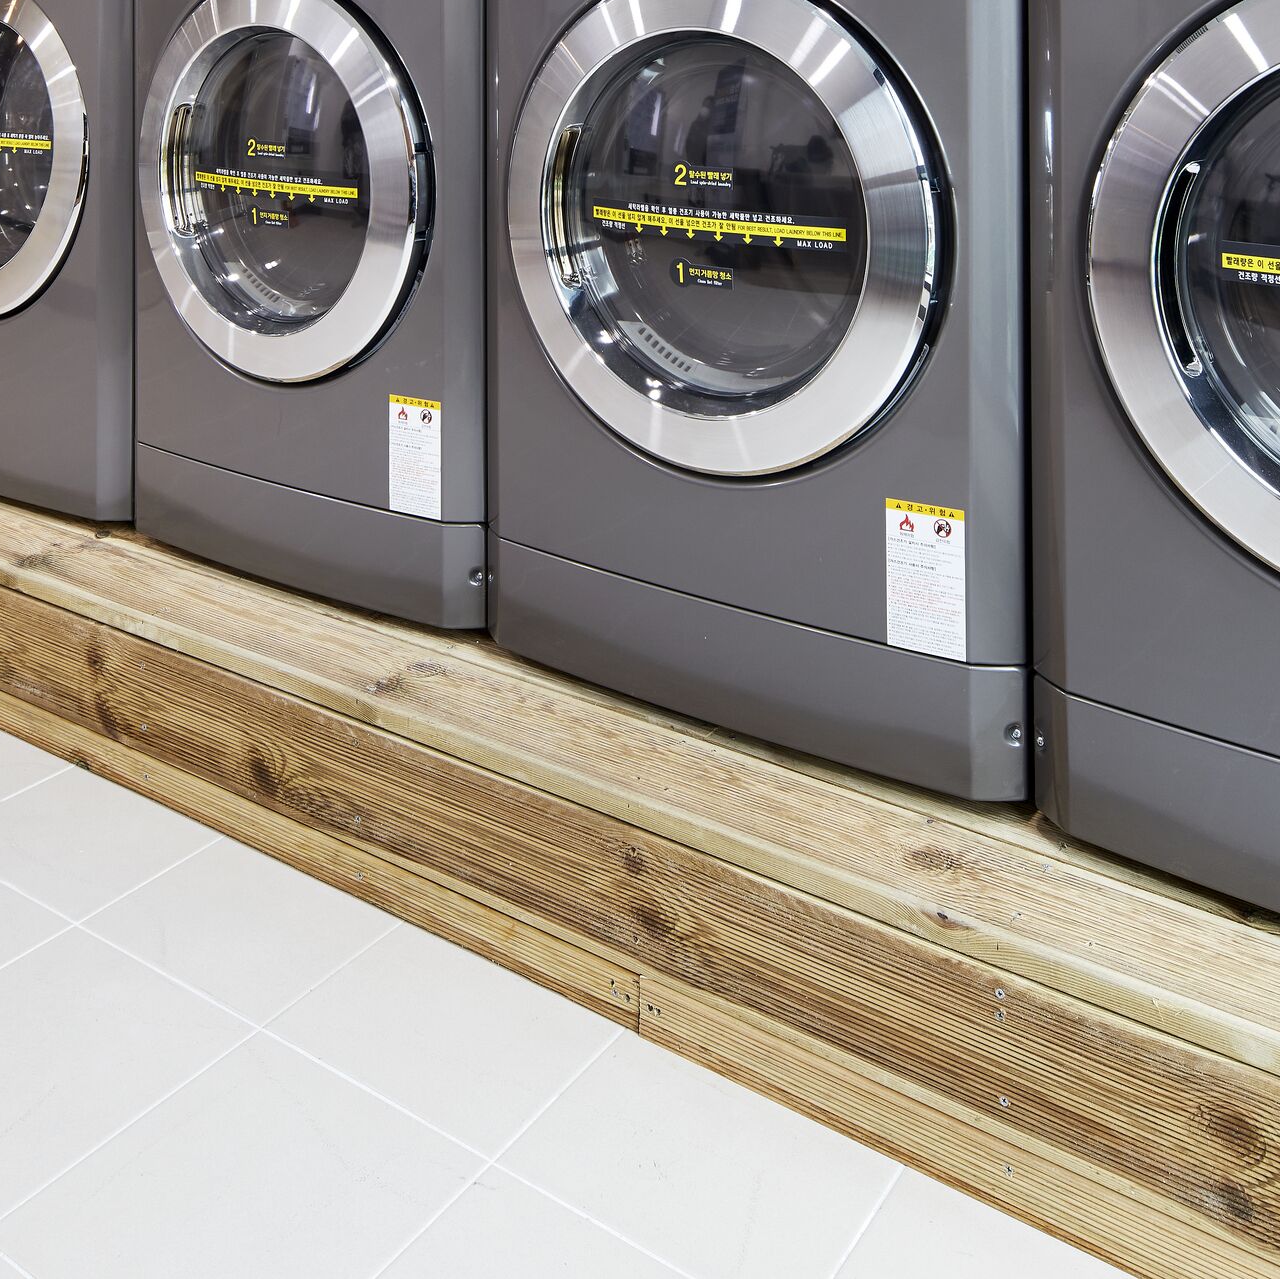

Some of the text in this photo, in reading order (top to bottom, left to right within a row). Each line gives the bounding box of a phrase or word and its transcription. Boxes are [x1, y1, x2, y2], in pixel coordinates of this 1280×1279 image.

[247, 138, 256, 157] 2
[674, 164, 687, 186] 2
[252, 207, 257, 224] 1
[797, 240, 833, 249] MAX LOAD
[1226, 256, 1254, 268] 빨래량은
[1257, 259, 1264, 269] 이
[1267, 260, 1280, 271] 선을
[677, 262, 684, 283] 1
[1238, 271, 1258, 282] 건조량
